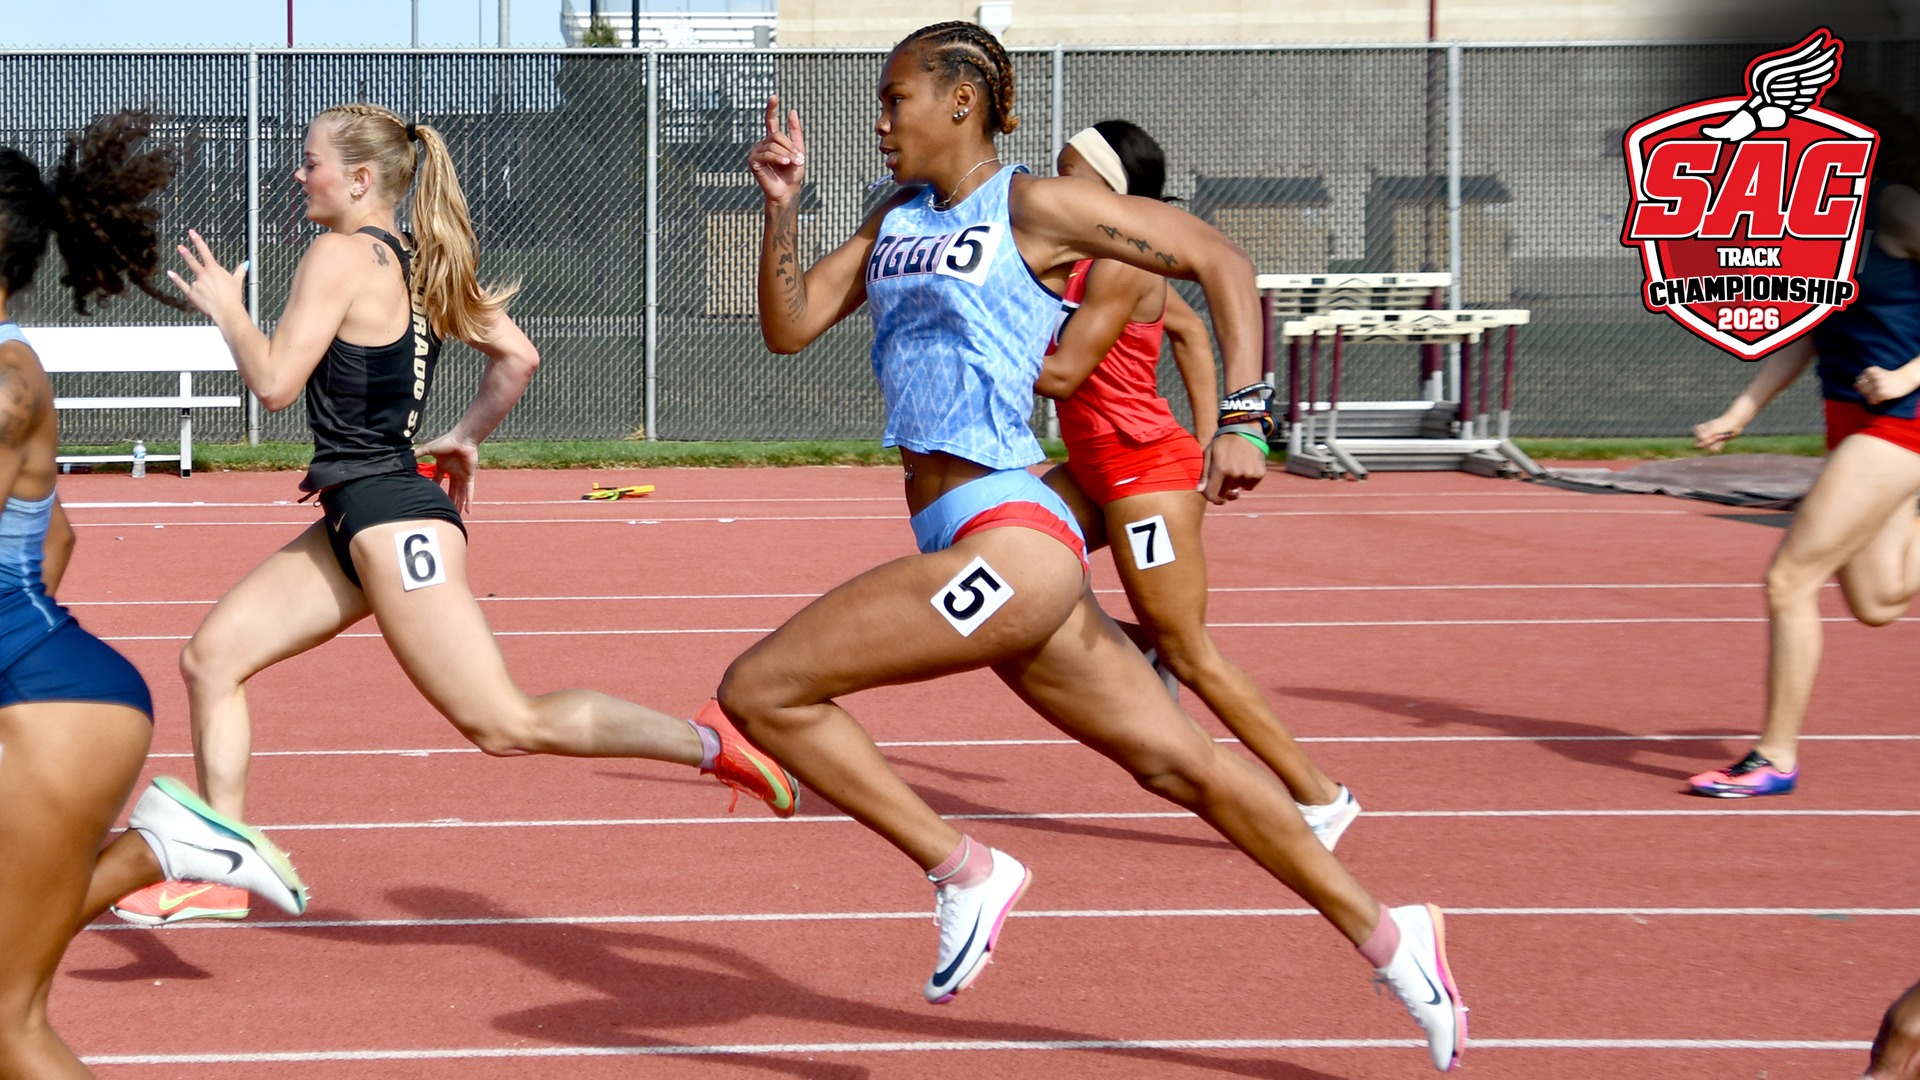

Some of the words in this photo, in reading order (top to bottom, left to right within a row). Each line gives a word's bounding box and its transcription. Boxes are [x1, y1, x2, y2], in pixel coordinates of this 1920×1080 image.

[946, 225, 991, 274] 5
[403, 533, 437, 583] 6
[1131, 522, 1157, 564] 7
[943, 566, 1001, 621] 5
